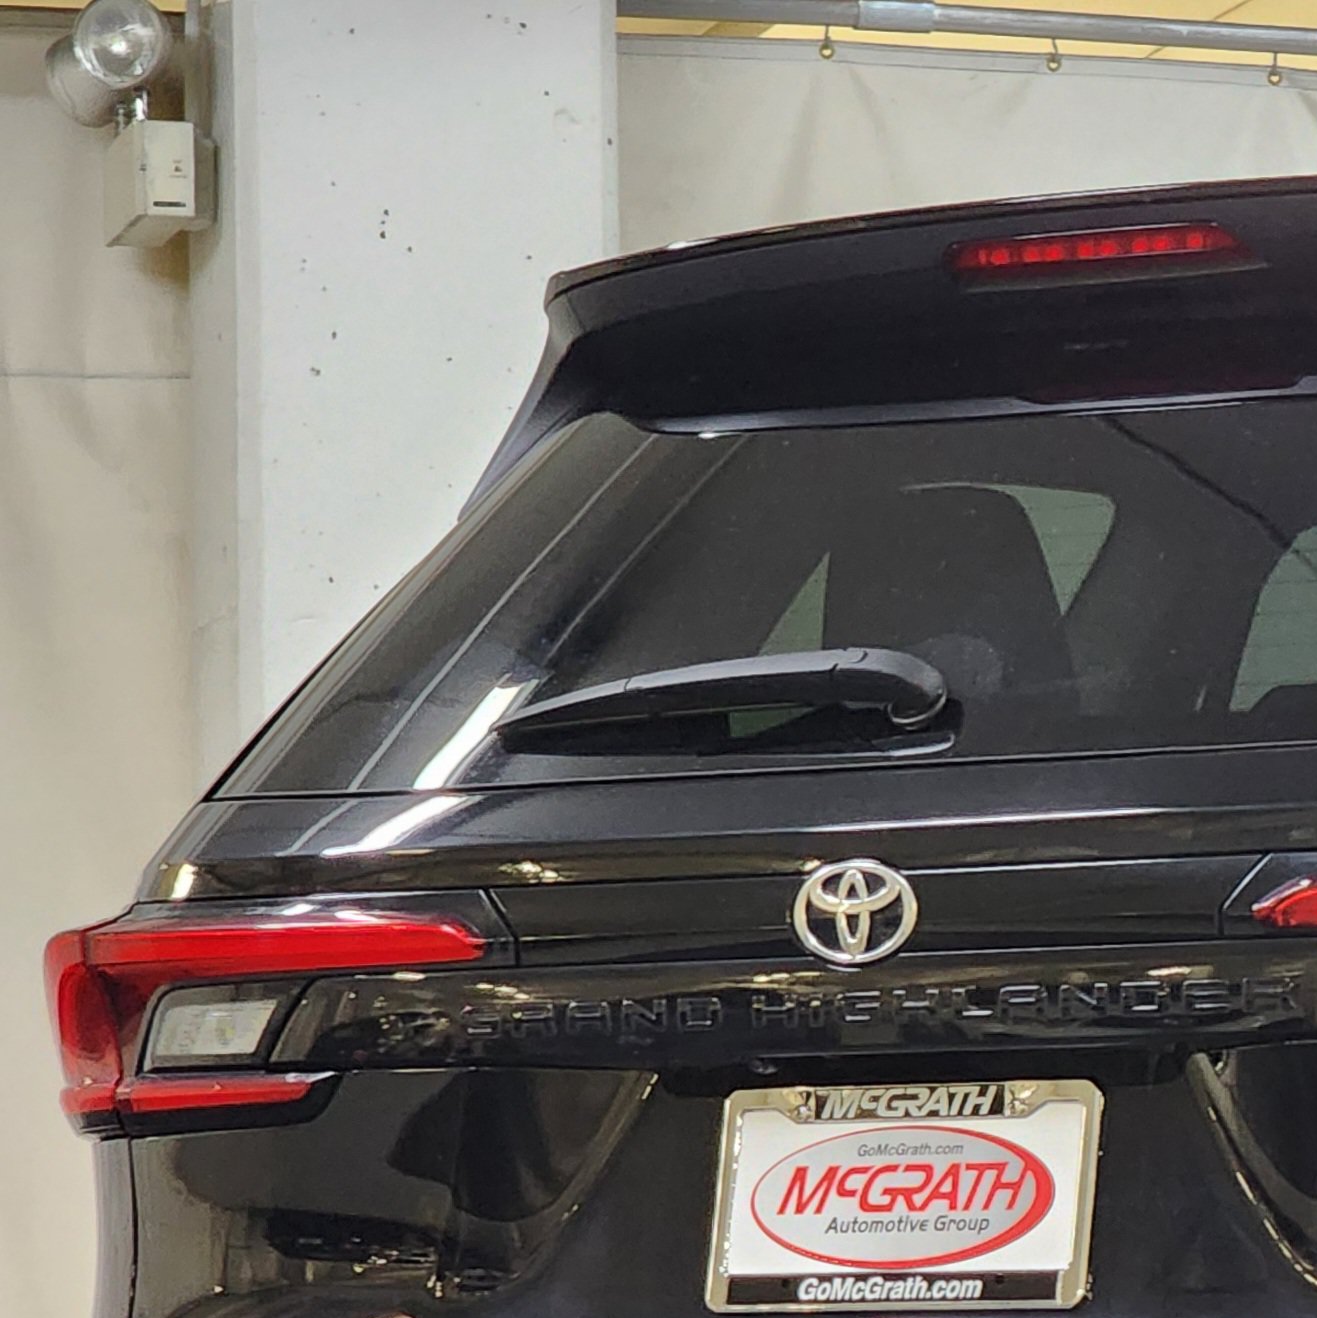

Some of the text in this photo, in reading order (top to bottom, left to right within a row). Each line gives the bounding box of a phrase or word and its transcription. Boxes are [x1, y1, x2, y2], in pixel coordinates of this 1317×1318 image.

[857, 1142, 964, 1158] GoMcGrath.com
[824, 1214, 990, 1235] Automotive Group
[796, 1275, 984, 1303] GoMcGrath.com
